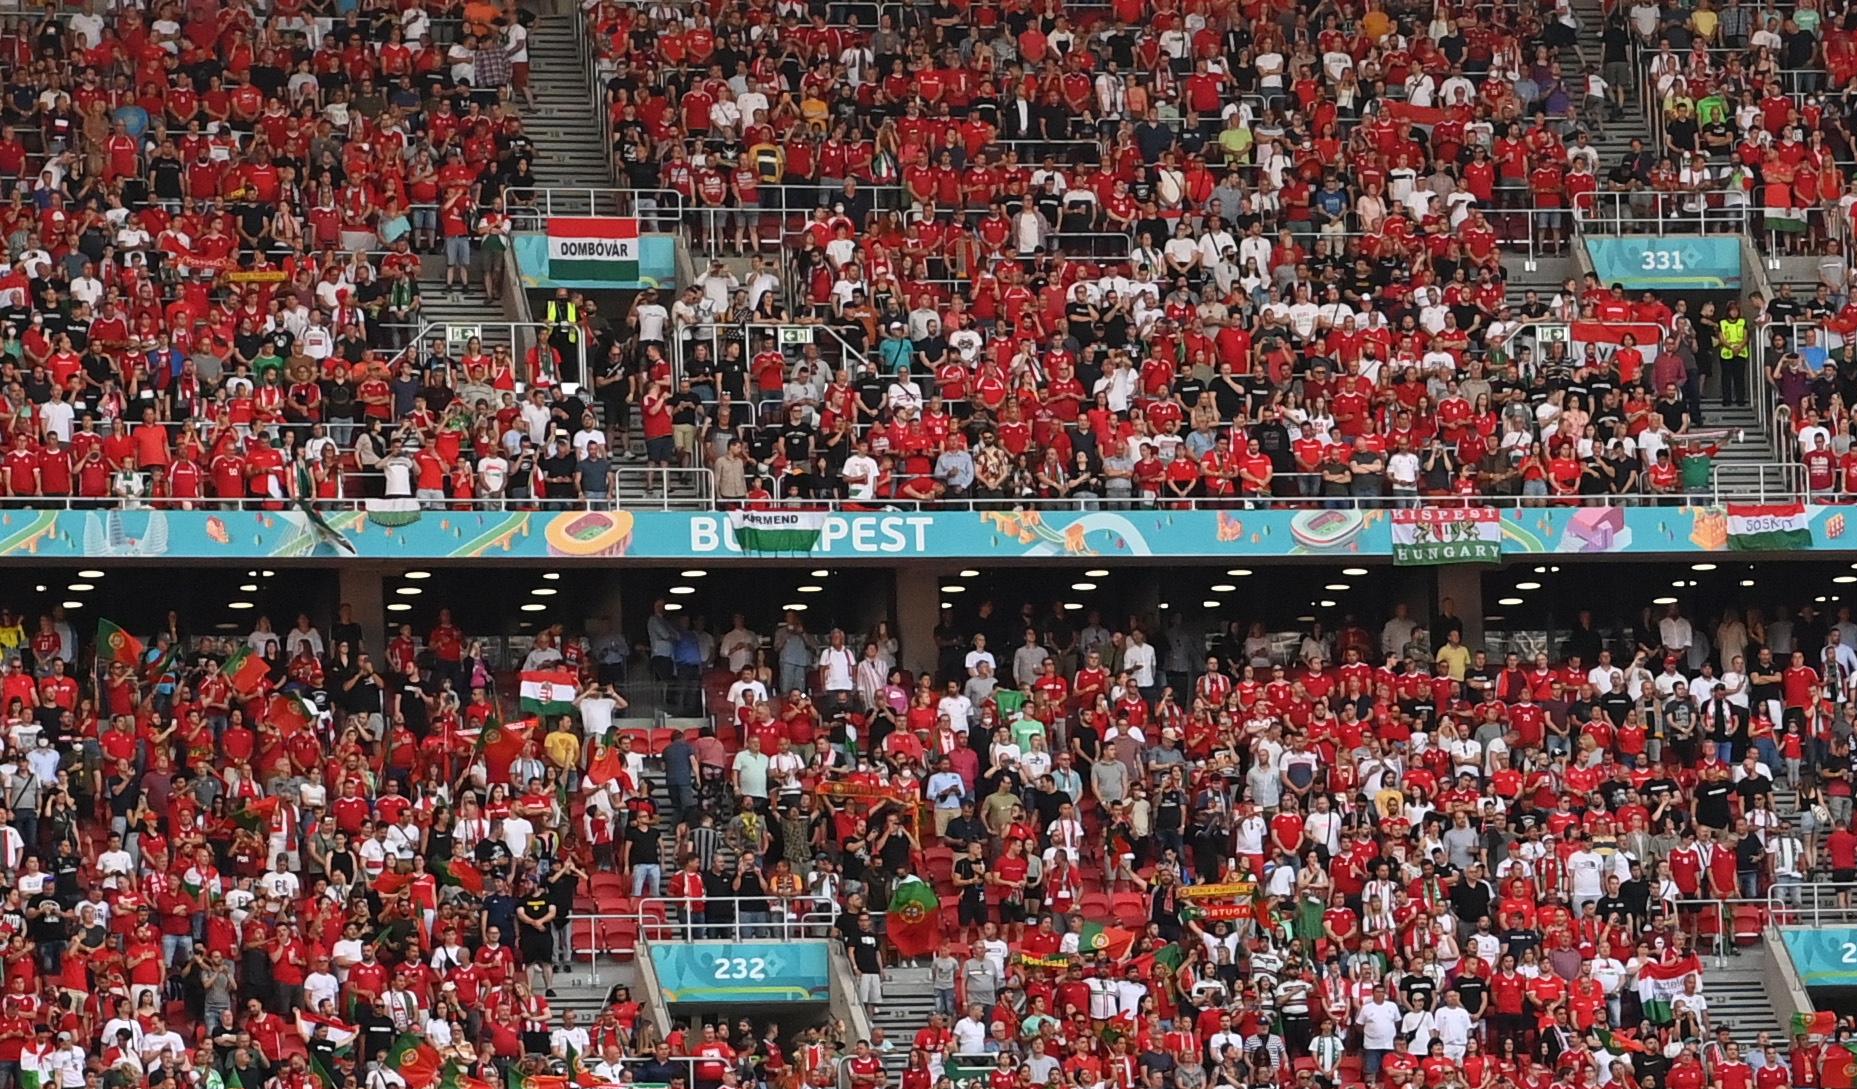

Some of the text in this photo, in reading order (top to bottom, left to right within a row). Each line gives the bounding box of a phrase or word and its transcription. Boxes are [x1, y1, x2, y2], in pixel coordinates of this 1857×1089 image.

[560, 239, 628, 257] DOMBÓVÁR
[1641, 251, 1683, 270] 331
[1392, 508, 1497, 520] KISPEST
[691, 516, 933, 552] BUPEST
[1398, 546, 1500, 561] HUNGARY
[714, 957, 765, 980] 232
